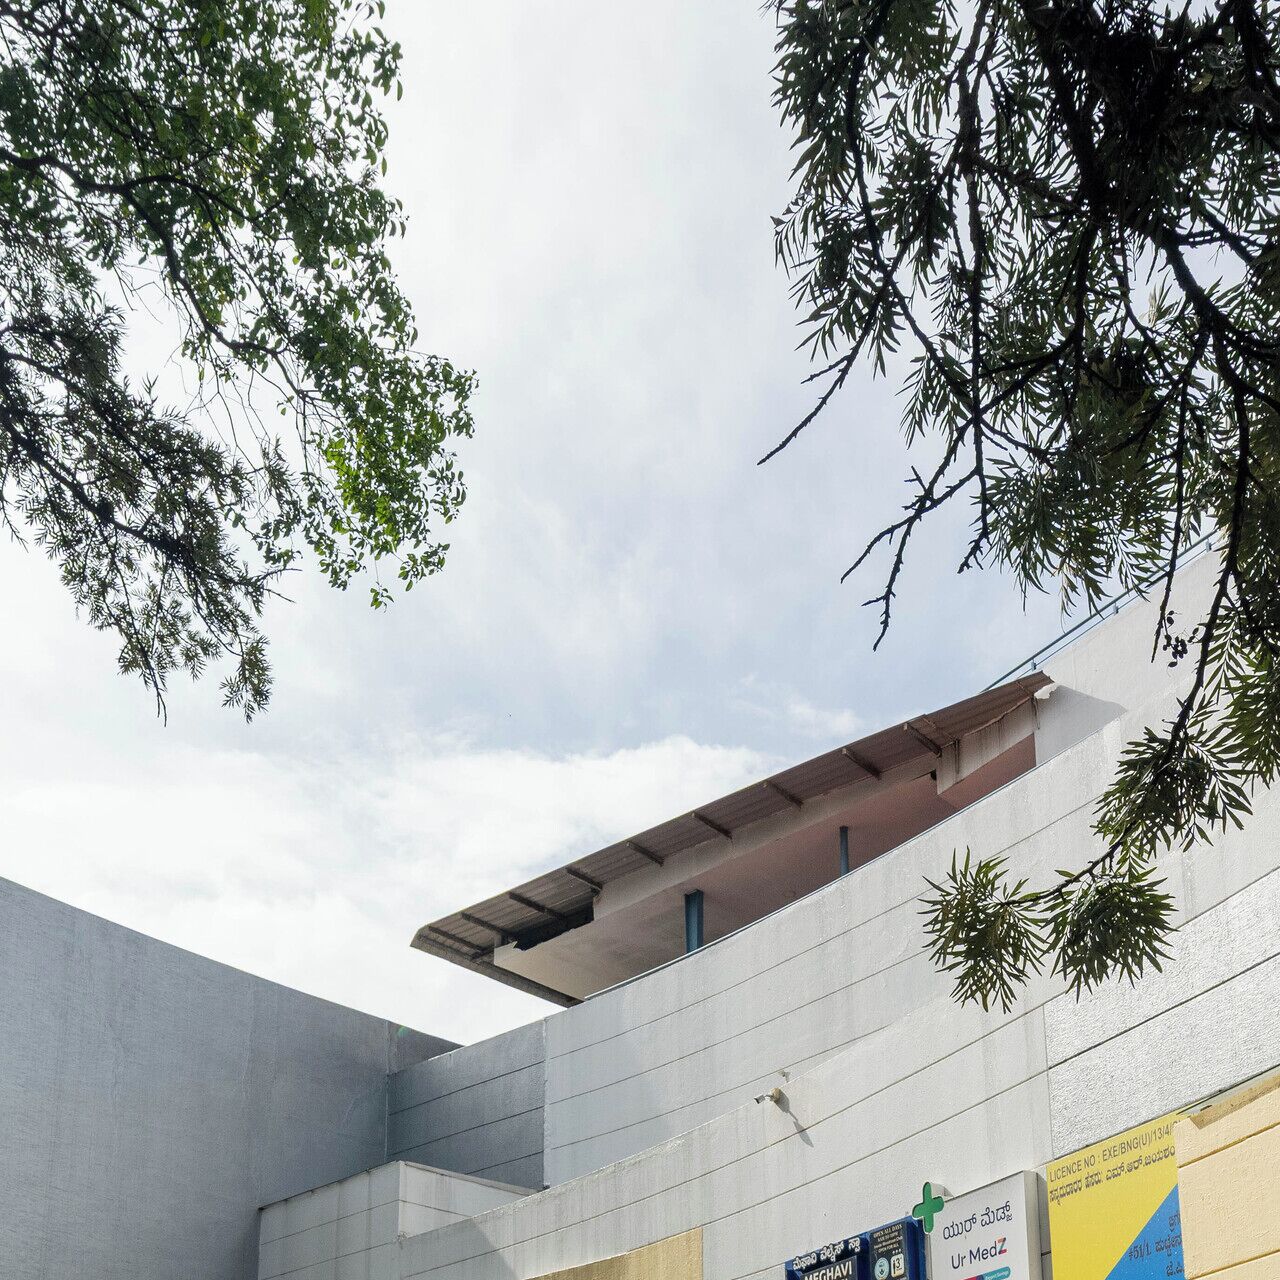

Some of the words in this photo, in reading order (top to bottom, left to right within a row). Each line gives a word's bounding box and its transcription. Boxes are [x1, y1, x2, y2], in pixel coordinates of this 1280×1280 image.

[1049, 1160, 1082, 1183] LICENCE
[1084, 1154, 1095, 1168] NO
[951, 1253, 966, 1269] Ur
[969, 1237, 1007, 1264] MedZ
